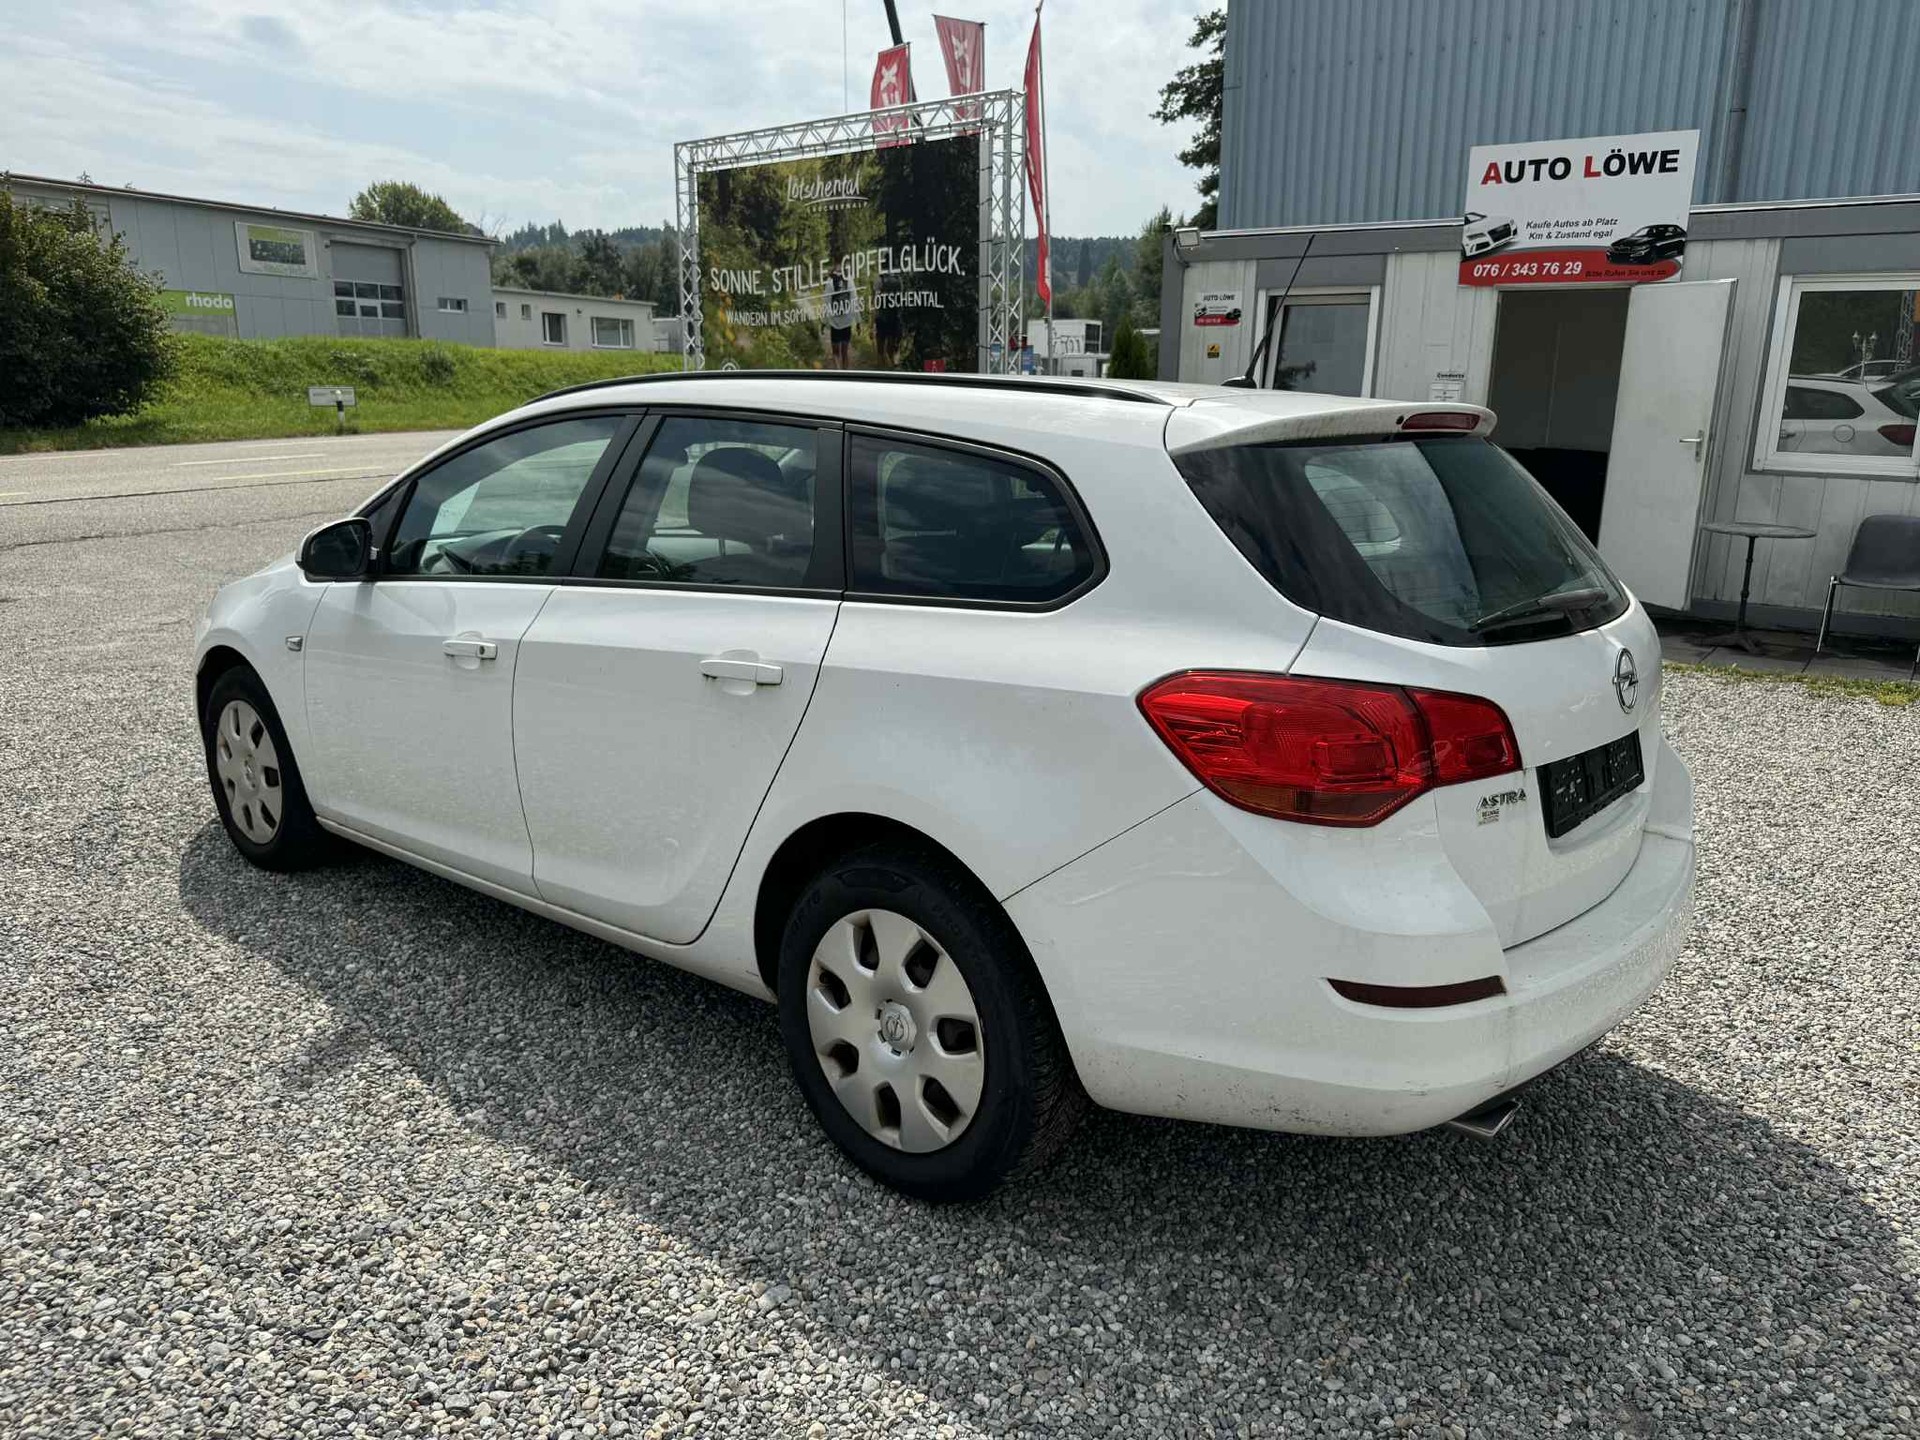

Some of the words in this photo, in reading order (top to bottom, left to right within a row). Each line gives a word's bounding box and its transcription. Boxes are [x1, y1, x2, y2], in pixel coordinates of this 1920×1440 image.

[1481, 157, 1572, 185] AUTO
[1583, 148, 1680, 178] LÖWE
[1525, 220, 1552, 230] Kaufe
[1553, 219, 1579, 229] Autos
[1582, 218, 1593, 227] ab
[1595, 217, 1618, 226] Platz
[1528, 232, 1544, 240] Km
[1546, 231, 1553, 240] &
[1555, 230, 1591, 240] Zustand
[1593, 229, 1613, 239] egal
[710, 267, 766, 298] SONNE,
[841, 236, 966, 281] GIPFELGLÜCK.
[1473, 263, 1500, 277] 076
[1511, 262, 1537, 277] 343
[1542, 262, 1560, 276] 76
[1563, 261, 1582, 275] 29
[186, 292, 233, 309] rhodo
[726, 310, 768, 327] WANDERN
[1476, 788, 1526, 810] ASTRA
